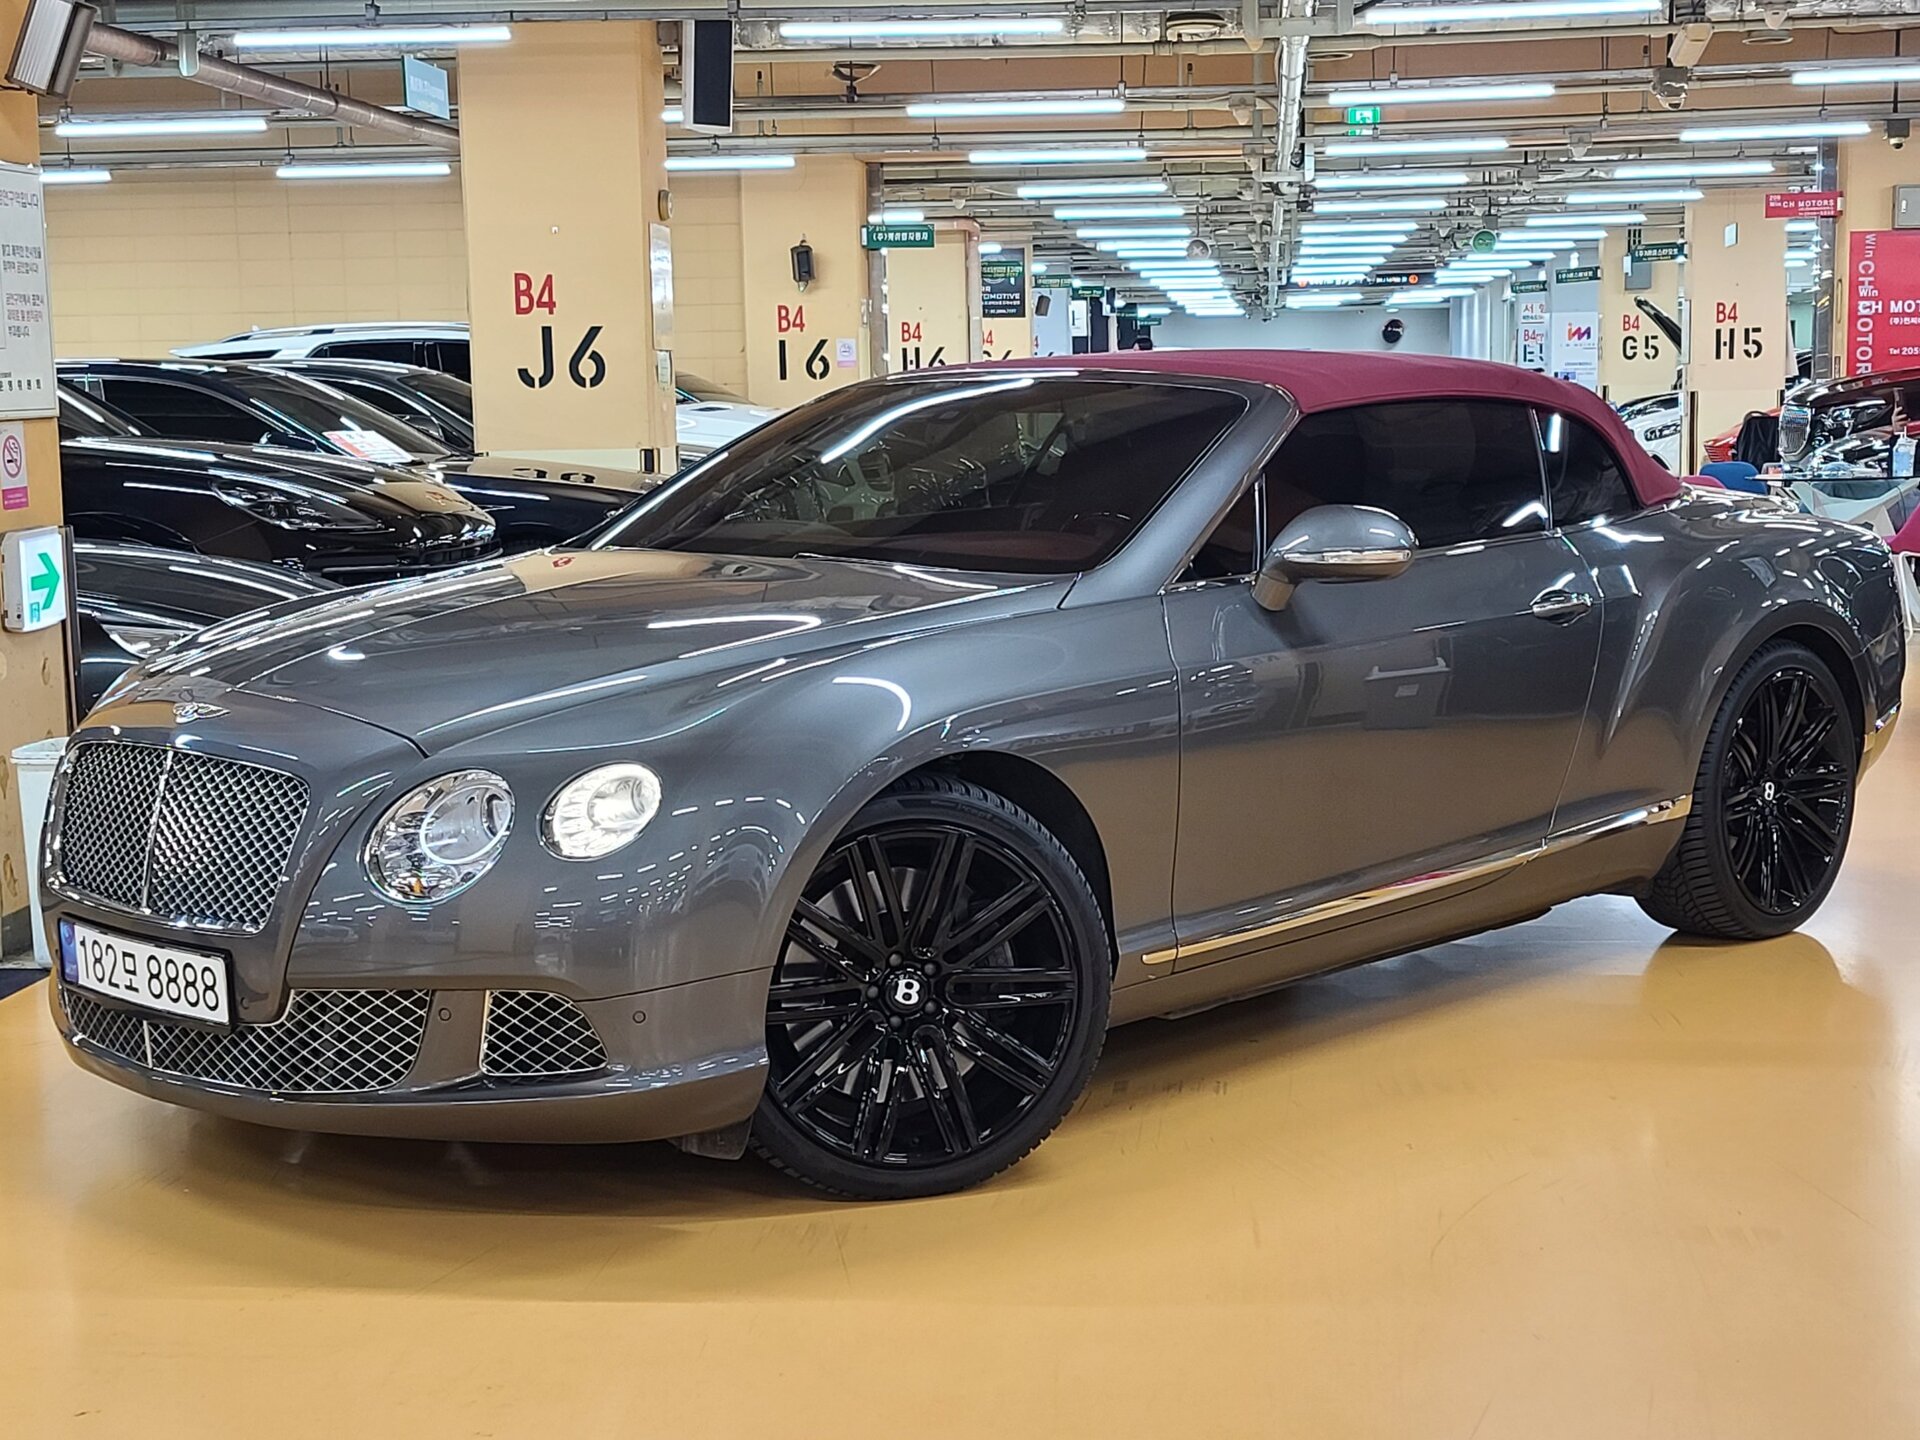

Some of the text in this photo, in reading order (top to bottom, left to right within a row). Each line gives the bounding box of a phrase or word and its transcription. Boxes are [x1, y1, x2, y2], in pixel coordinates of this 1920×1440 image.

[1782, 201, 1795, 209] CH
[1797, 199, 1835, 208] MOTORS
[514, 272, 556, 315] B4
[777, 305, 805, 333] B4
[1622, 314, 1640, 332] B4
[1716, 302, 1738, 324] B4
[901, 322, 922, 342] B4
[517, 326, 606, 389] J6
[1901, 346, 1920, 355] 205
[79, 936, 220, 1012] 182모 8888
[895, 979, 920, 1005] B
